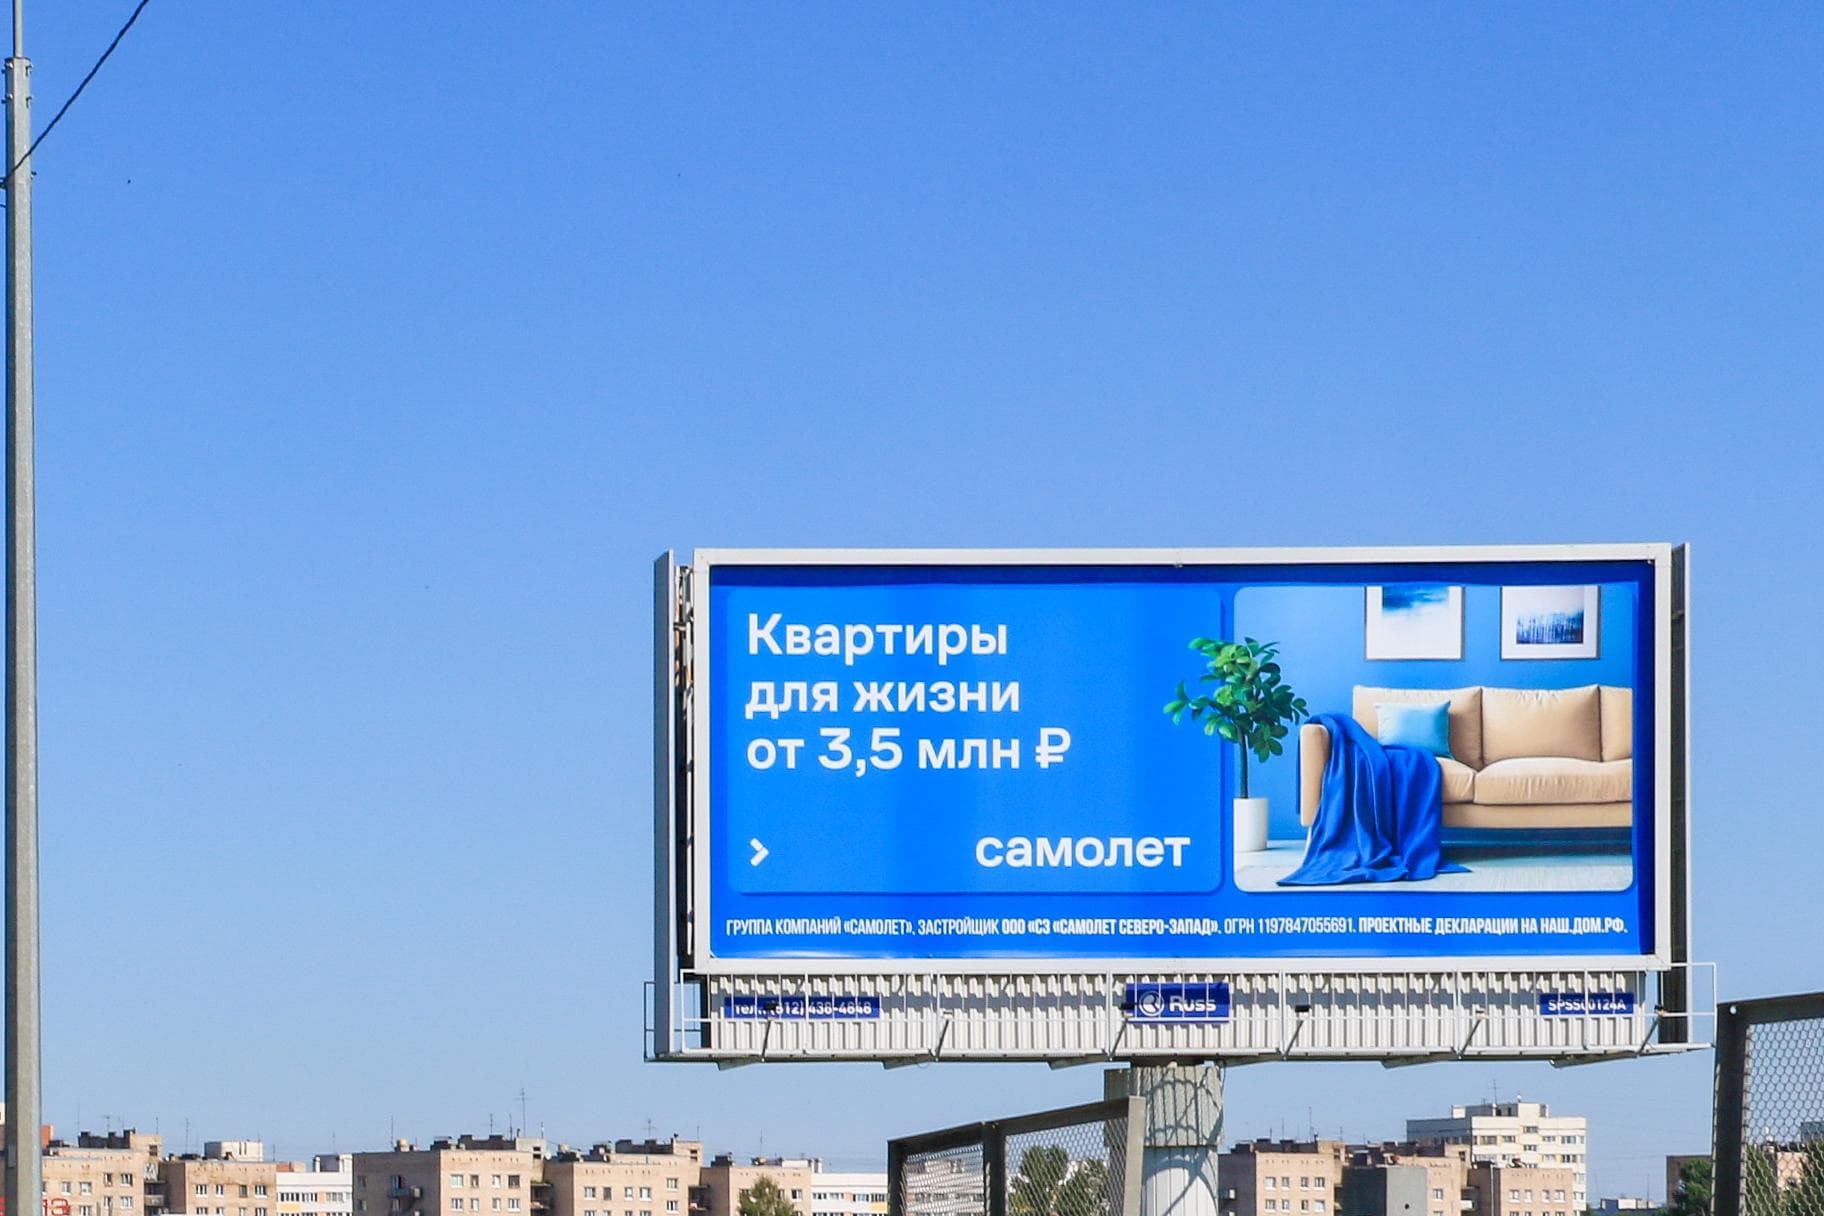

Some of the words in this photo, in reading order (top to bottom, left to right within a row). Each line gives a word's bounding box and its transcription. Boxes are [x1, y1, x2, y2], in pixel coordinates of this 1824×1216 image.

[748, 613, 1008, 666] Квартиры
[744, 681, 839, 720] для
[852, 681, 1020, 713] жизни
[746, 738, 805, 770] от
[818, 727, 903, 778] 3,5
[918, 738, 1020, 769] млн
[1034, 727, 1072, 769] ₽
[975, 836, 1191, 868] самолет
[726, 918, 773, 936] ГРУППА
[775, 915, 842, 935] КОМПАНИЙ
[917, 915, 1000, 936] ЗАСТРОЙЩИК
[1001, 918, 1026, 935] ООО
[1052, 918, 1117, 935] «САМОЛЕТ
[1118, 918, 1222, 936] СЕВЕРО-ЗАПАД».
[1223, 917, 1255, 935] ОГРН
[1258, 917, 1356, 934] 1197847055691.
[1358, 916, 1433, 934] ПРОЕКТНЫЕ
[1434, 917, 1519, 936] ДЕКЛАРАЦИИ
[1520, 917, 1539, 934] НА
[1540, 916, 1628, 935] НАШ.ДОМ.РФ.
[1169, 994, 1217, 1013] Russ
